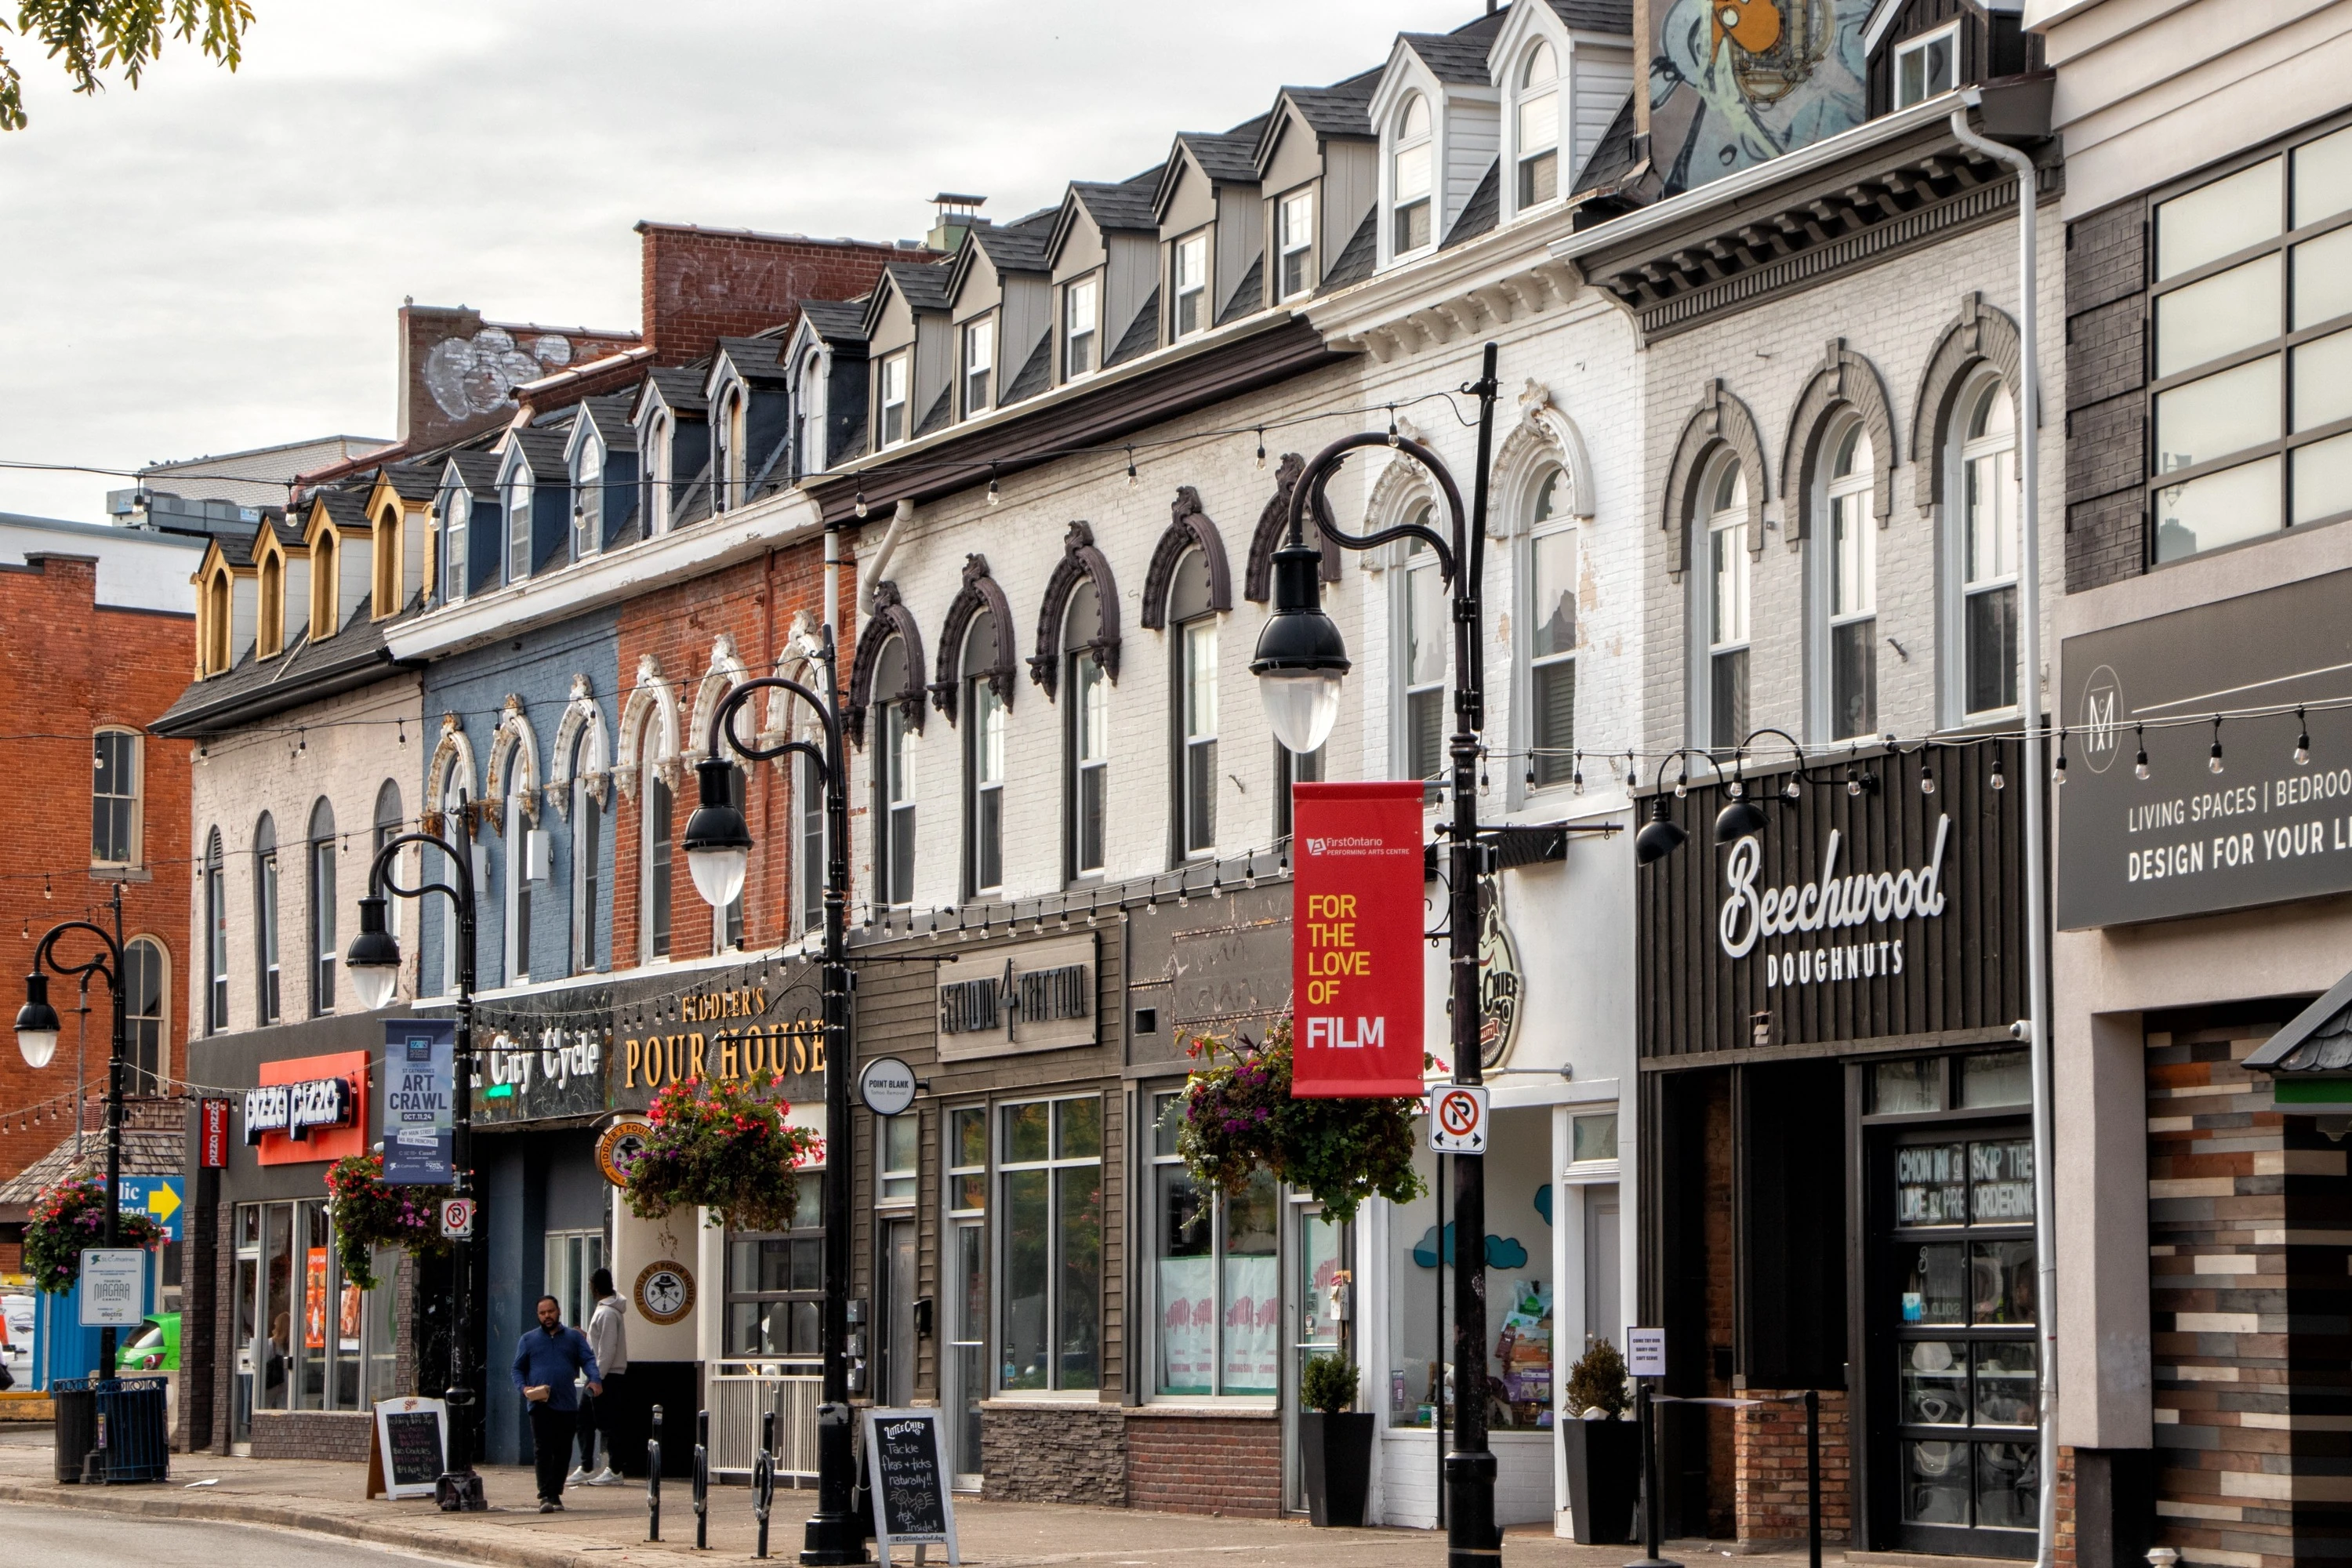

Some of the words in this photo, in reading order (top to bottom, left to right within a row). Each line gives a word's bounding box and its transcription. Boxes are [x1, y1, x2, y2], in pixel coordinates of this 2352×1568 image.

[2129, 799, 2184, 833] LIVING
[2191, 786, 2256, 821] SPACES
[1327, 837, 1382, 847] FirstOntario
[2129, 840, 2203, 882] DESIGN
[2213, 833, 2254, 869] FOR
[2263, 821, 2324, 861] YOUR
[1721, 813, 1950, 958] Beechwood
[1308, 895, 1356, 919] FOR
[1307, 923, 1356, 947] THE
[1308, 951, 1370, 976] LOVE
[1767, 939, 1903, 987] DOUGHNUTS
[681, 987, 766, 1023] FIDDLER'S
[940, 978, 997, 1033] STUDIO
[996, 958, 1017, 1042] 4
[1017, 964, 1086, 1023] TATTOO
[1308, 980, 1341, 1004] OF
[1483, 968, 1519, 1014] CHIEF
[1307, 1016, 1385, 1048] FILM
[491, 1034, 535, 1094] City
[543, 1028, 600, 1090] Cycle
[625, 1033, 706, 1088] POUR
[719, 1019, 826, 1080] HOUSE
[402, 1074, 434, 1091] ART
[210, 1101, 222, 1133] pizza
[245, 1085, 288, 1145] pizza
[290, 1080, 338, 1142] pizza
[390, 1093, 447, 1109] CRAWL
[209, 1135, 220, 1167] pizza
[602, 1127, 624, 1168] FIDDLER'S
[1973, 1146, 2002, 1180] SKIP
[2007, 1144, 2033, 1178] THE
[1944, 1186, 1964, 1218] PRE
[94, 1283, 130, 1301] NIAGARA
[636, 1265, 658, 1305] FIDDLER'S
[660, 1262, 684, 1273] POUR
[683, 1275, 694, 1306] HOUSE
[884, 1423, 905, 1439] LITTLE
[904, 1421, 925, 1433] CHIEF
[881, 1455, 903, 1472] fleas
[911, 1457, 932, 1471] ticks
[886, 1443, 919, 1454] Tackle
[888, 1472, 934, 1488] naturally!!
[896, 1512, 915, 1523] Ask
[905, 1520, 939, 1533] Inside!!
[902, 1534, 945, 1542] @littlechief.dog
